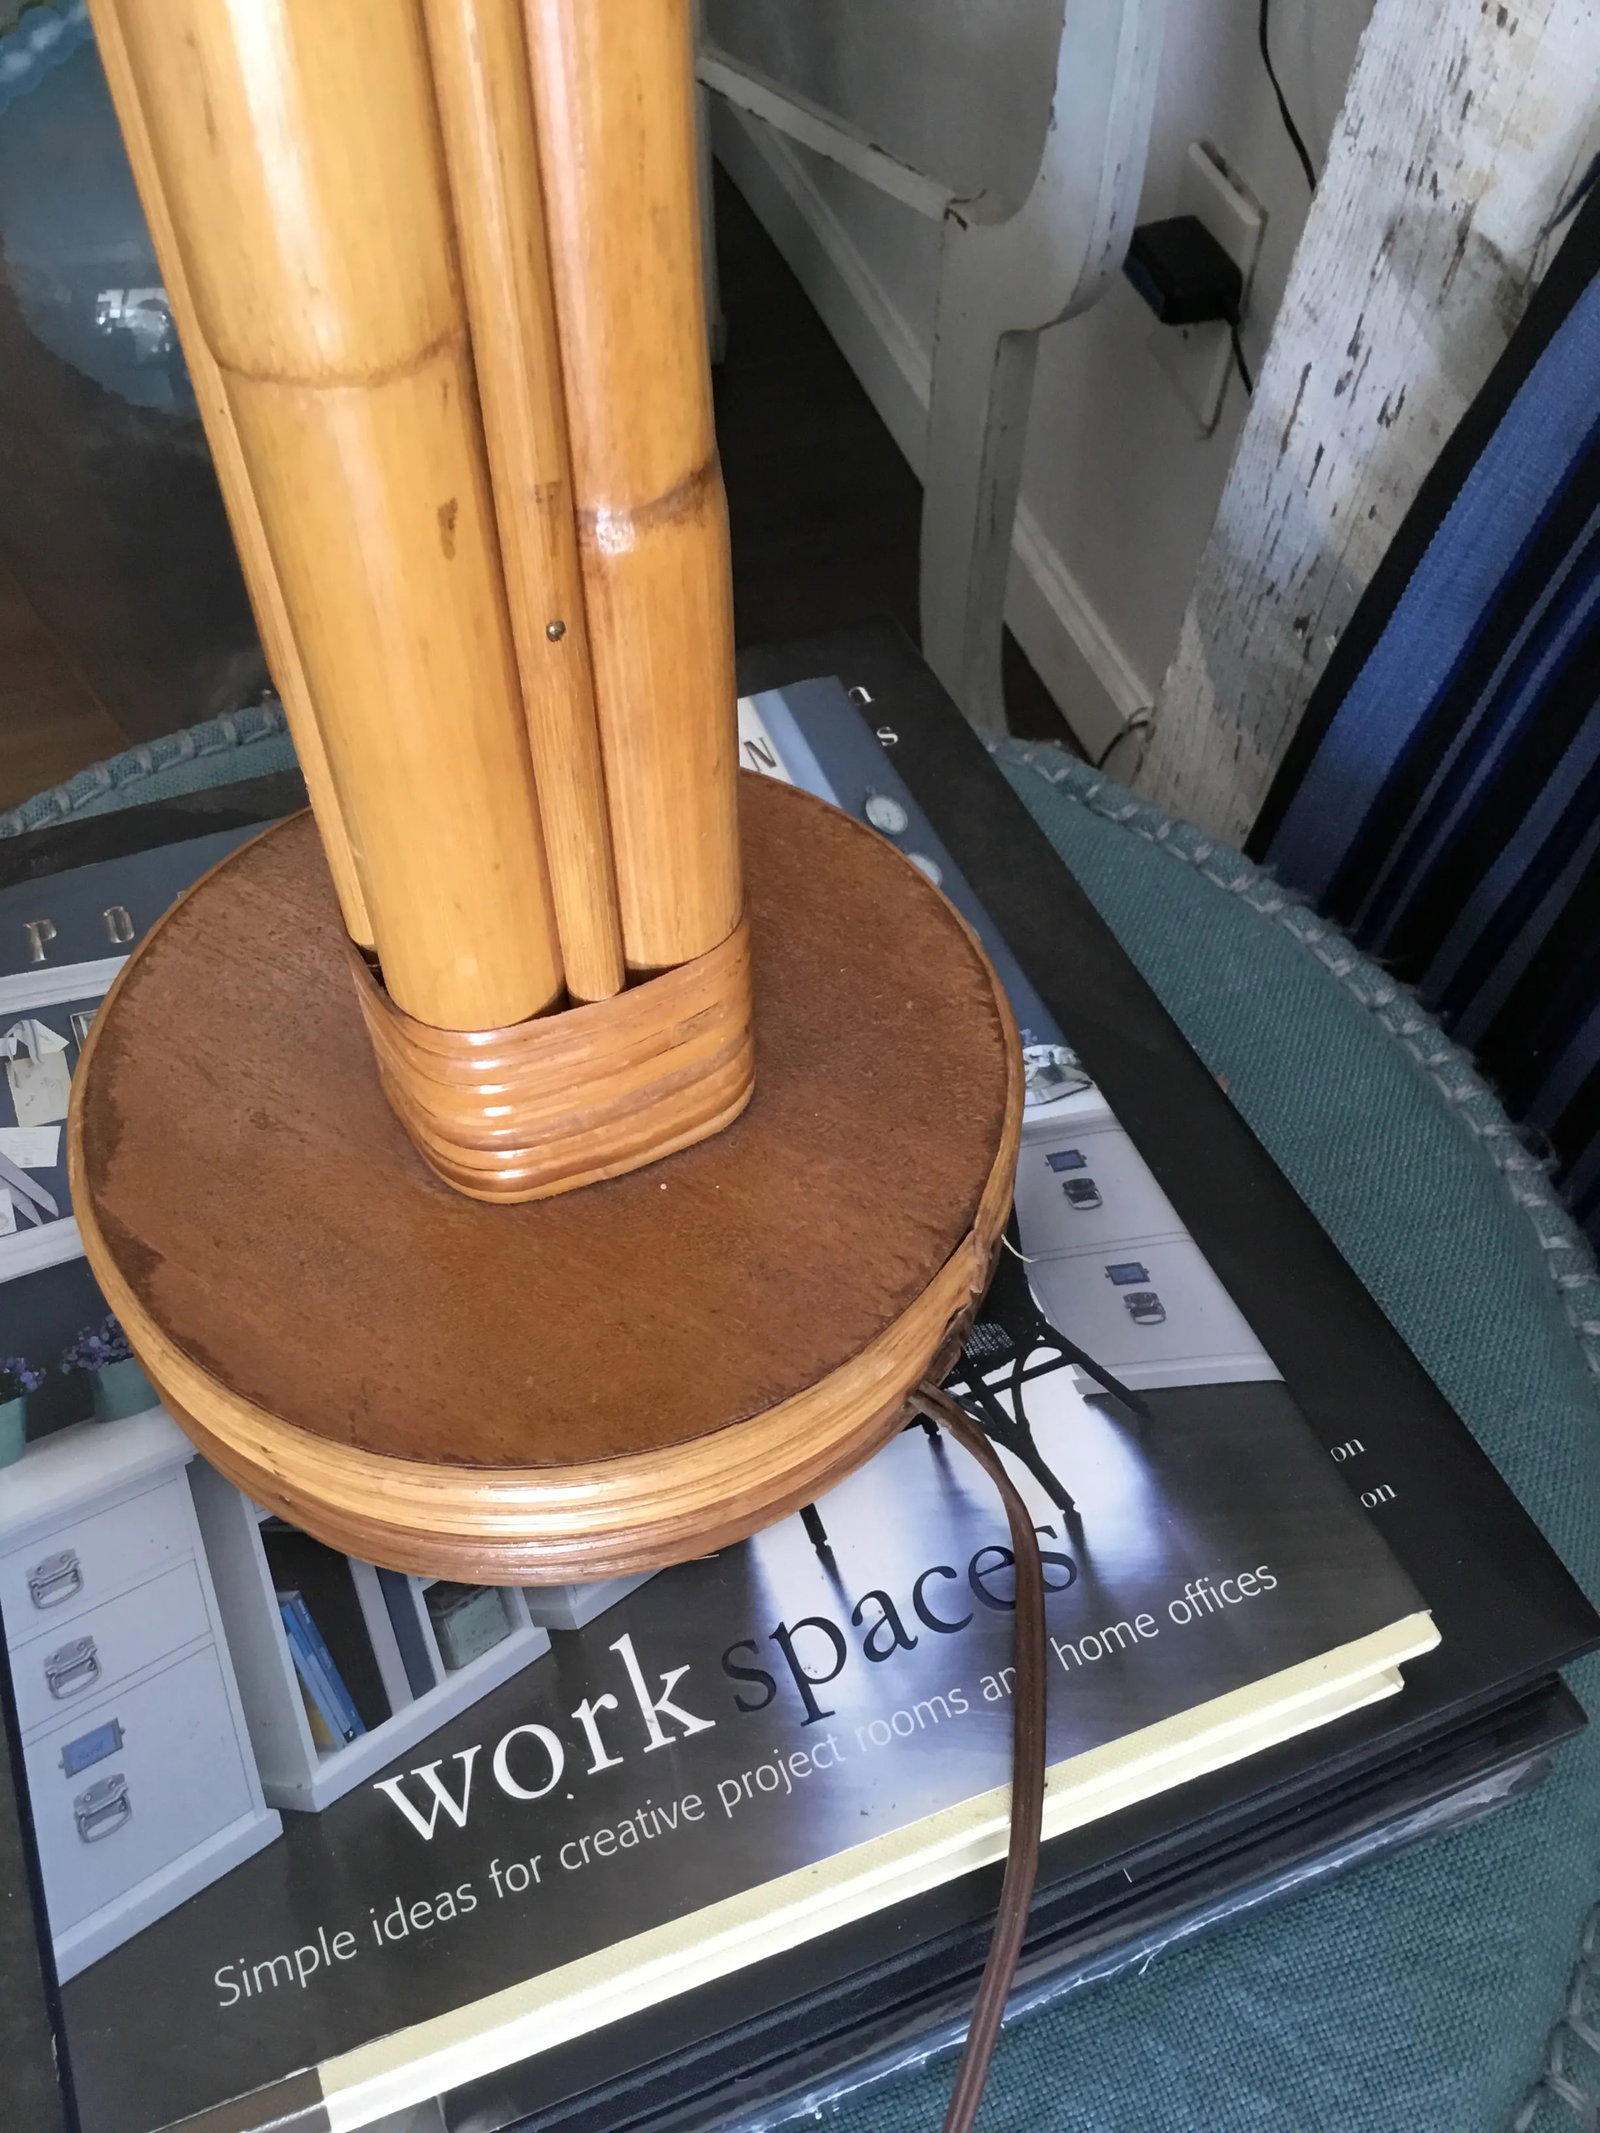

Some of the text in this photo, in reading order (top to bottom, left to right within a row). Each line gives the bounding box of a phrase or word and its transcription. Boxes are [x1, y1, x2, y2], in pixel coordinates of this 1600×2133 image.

[1330, 1438, 1367, 1463] on
[1360, 1483, 1398, 1509] on
[373, 1524, 1078, 1841] work spaces
[213, 1926, 358, 2007] Simple
[369, 1881, 478, 1947] ideas
[488, 1853, 544, 1899] for
[559, 1793, 706, 1871] creative
[716, 1732, 846, 1819] project
[854, 1687, 969, 1753] rooms
[1049, 1612, 1160, 1672] home
[1167, 1564, 1278, 1626] offices
